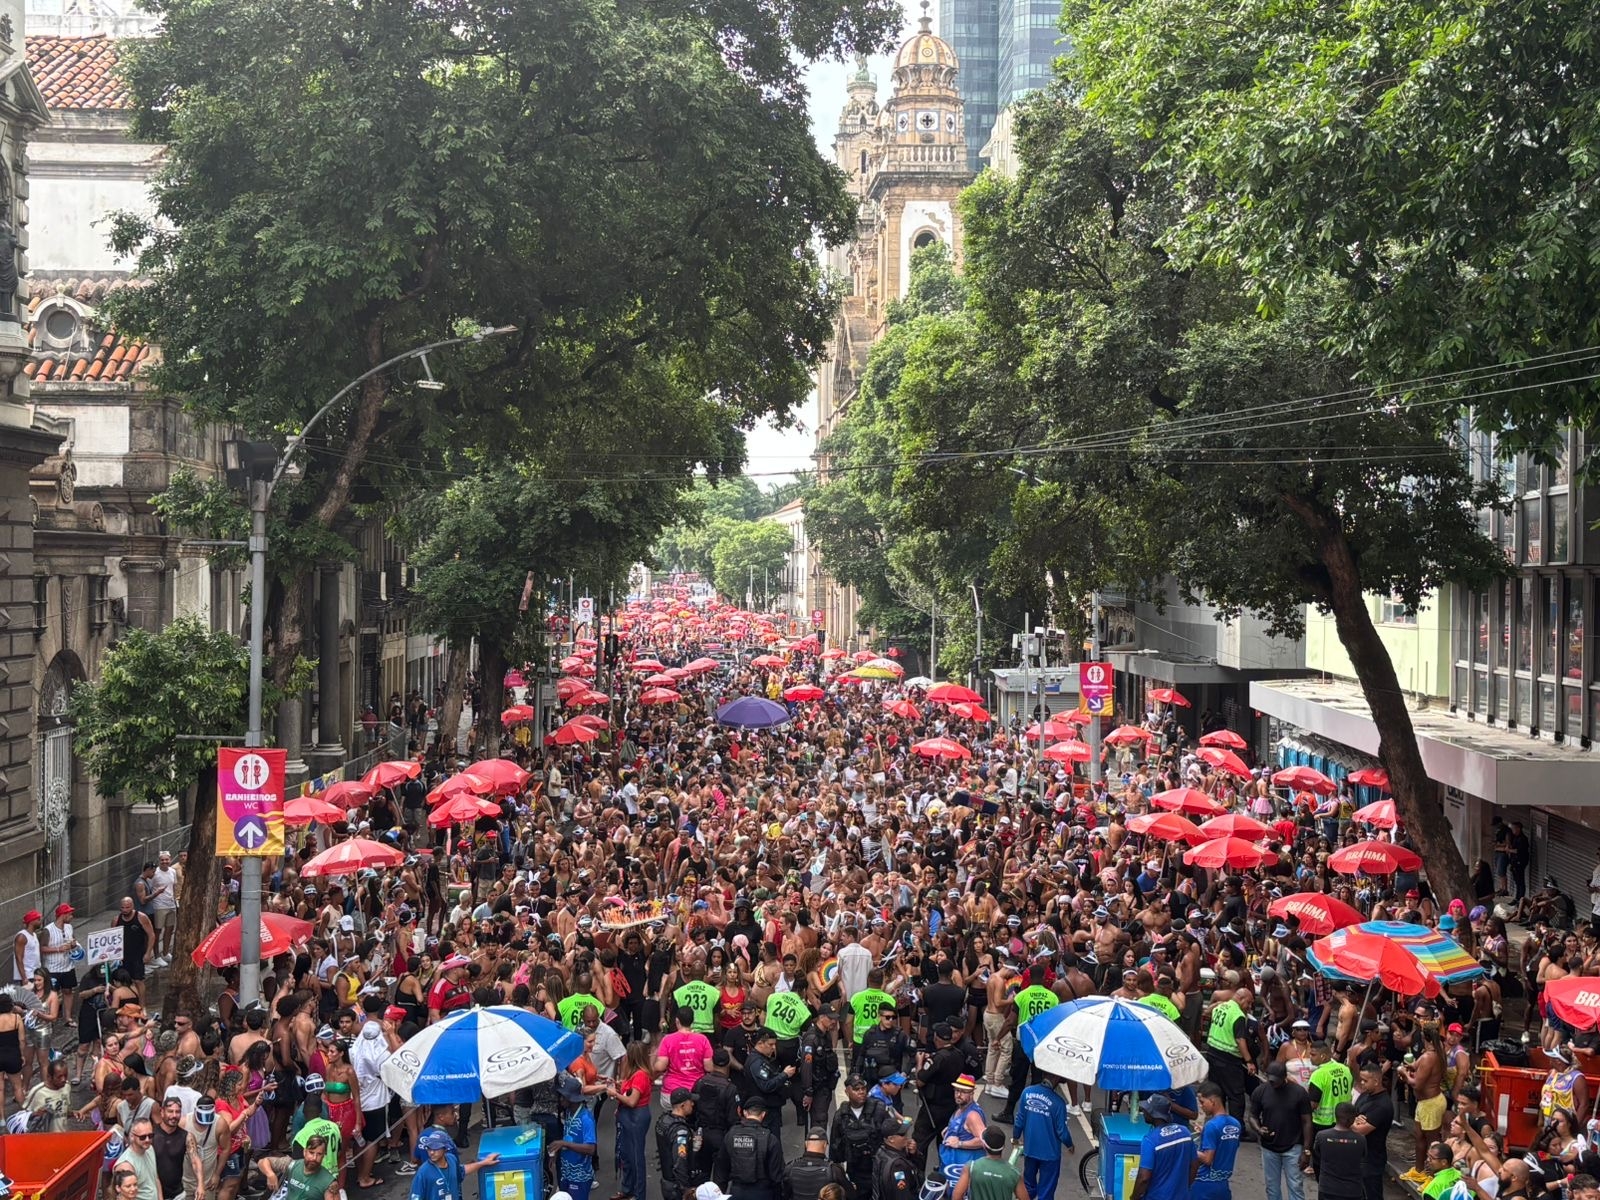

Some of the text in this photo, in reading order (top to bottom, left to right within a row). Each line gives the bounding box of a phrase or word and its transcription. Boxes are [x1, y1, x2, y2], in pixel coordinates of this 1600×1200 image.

[225, 793, 277, 802] BANHEIROS
[244, 802, 259, 810] WC
[1344, 850, 1387, 863] BRAHMA
[1284, 901, 1327, 923] BRAHMA
[89, 935, 122, 949] LEQUES
[684, 994, 708, 1011] 233
[782, 994, 799, 1006] UNIPAZ
[772, 1001, 796, 1024] 249
[863, 1004, 878, 1020] 58
[1046, 1043, 1094, 1064] CEDAE
[1169, 1053, 1198, 1068] CEDAE
[487, 1052, 541, 1073] CEDAE
[1127, 1063, 1163, 1071] HIDRATAÇÃO
[1331, 1077, 1349, 1097] 619
[1024, 1105, 1050, 1117] CEDAE
